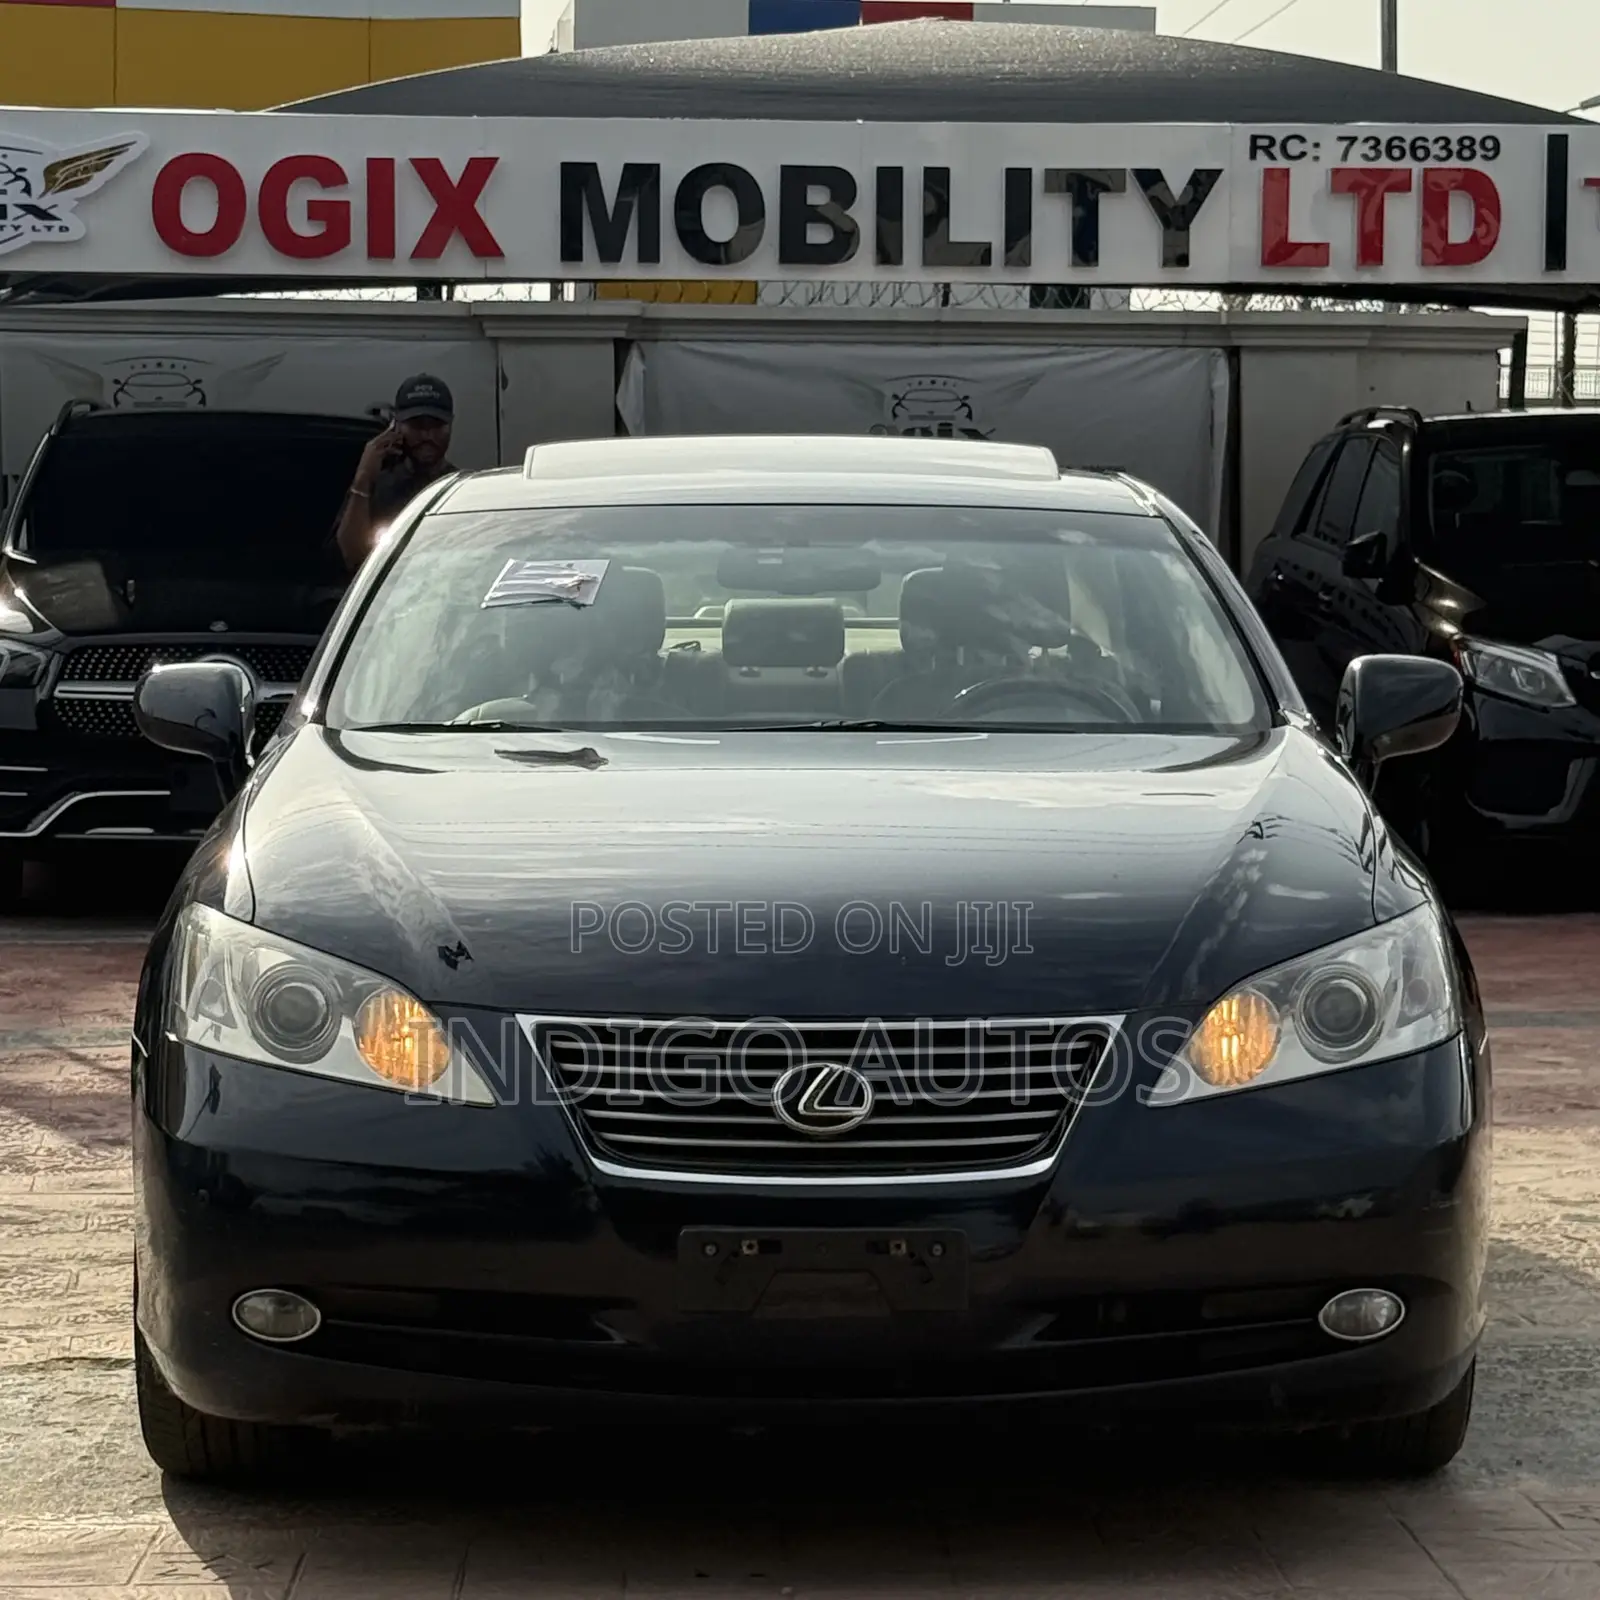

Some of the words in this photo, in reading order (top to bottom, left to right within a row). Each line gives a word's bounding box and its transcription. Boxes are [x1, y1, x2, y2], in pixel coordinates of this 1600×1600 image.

[1249, 134, 1321, 162] RC:
[1336, 135, 1501, 163] 7366389
[152, 152, 505, 260] OGIX
[560, 161, 1223, 268] MOBILITY
[1261, 168, 1501, 266] LTD
[31, 224, 70, 233] LTD
